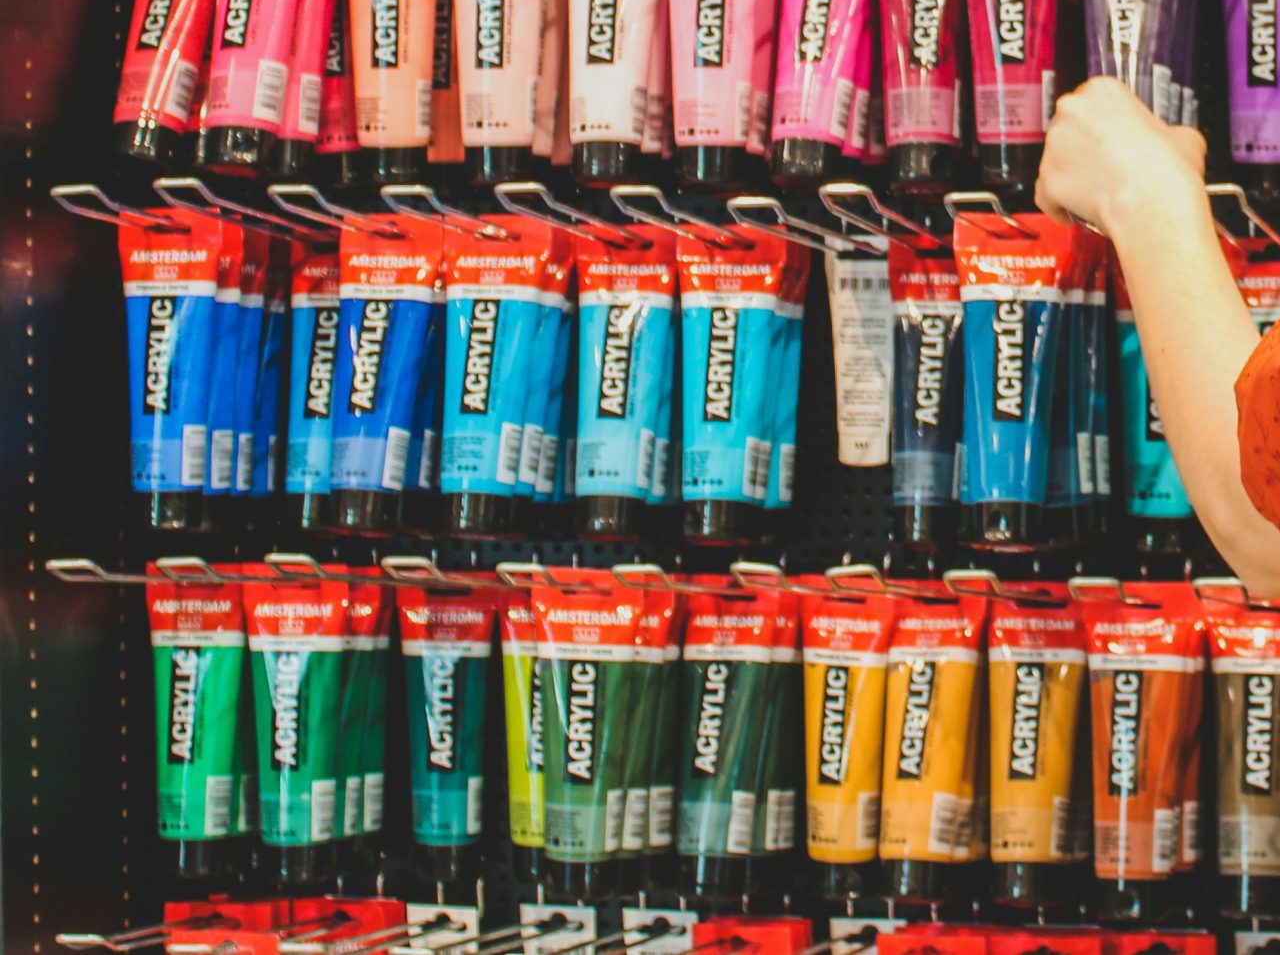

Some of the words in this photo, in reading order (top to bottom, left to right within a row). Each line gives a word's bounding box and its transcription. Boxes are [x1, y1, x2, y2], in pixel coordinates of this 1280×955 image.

[130, 249, 208, 264] AMSTERDAM
[146, 299, 174, 411] ACRYLIC
[307, 310, 338, 415] ACRYLIC
[351, 301, 388, 410] ACRYLIC
[463, 301, 497, 411] ACRYLIC
[705, 308, 738, 420] ACRYLIC
[915, 316, 946, 426] ACRYLIC
[995, 299, 1025, 417] ACRYLIC
[547, 610, 632, 626] AMSTERDAM
[171, 650, 198, 760] ACRYLIC
[274, 654, 299, 766] ACRYLIC
[430, 658, 454, 769] ACRYLIC
[567, 662, 597, 780] ACRYLIC
[695, 663, 729, 775] ACRYLIC
[820, 668, 848, 781] ACRYLIC
[900, 664, 933, 775] ACRYLIC
[1011, 665, 1041, 776] ACRYLIC
[1111, 672, 1139, 789] ACRYLIC
[1246, 676, 1274, 790] ACRYLIC
